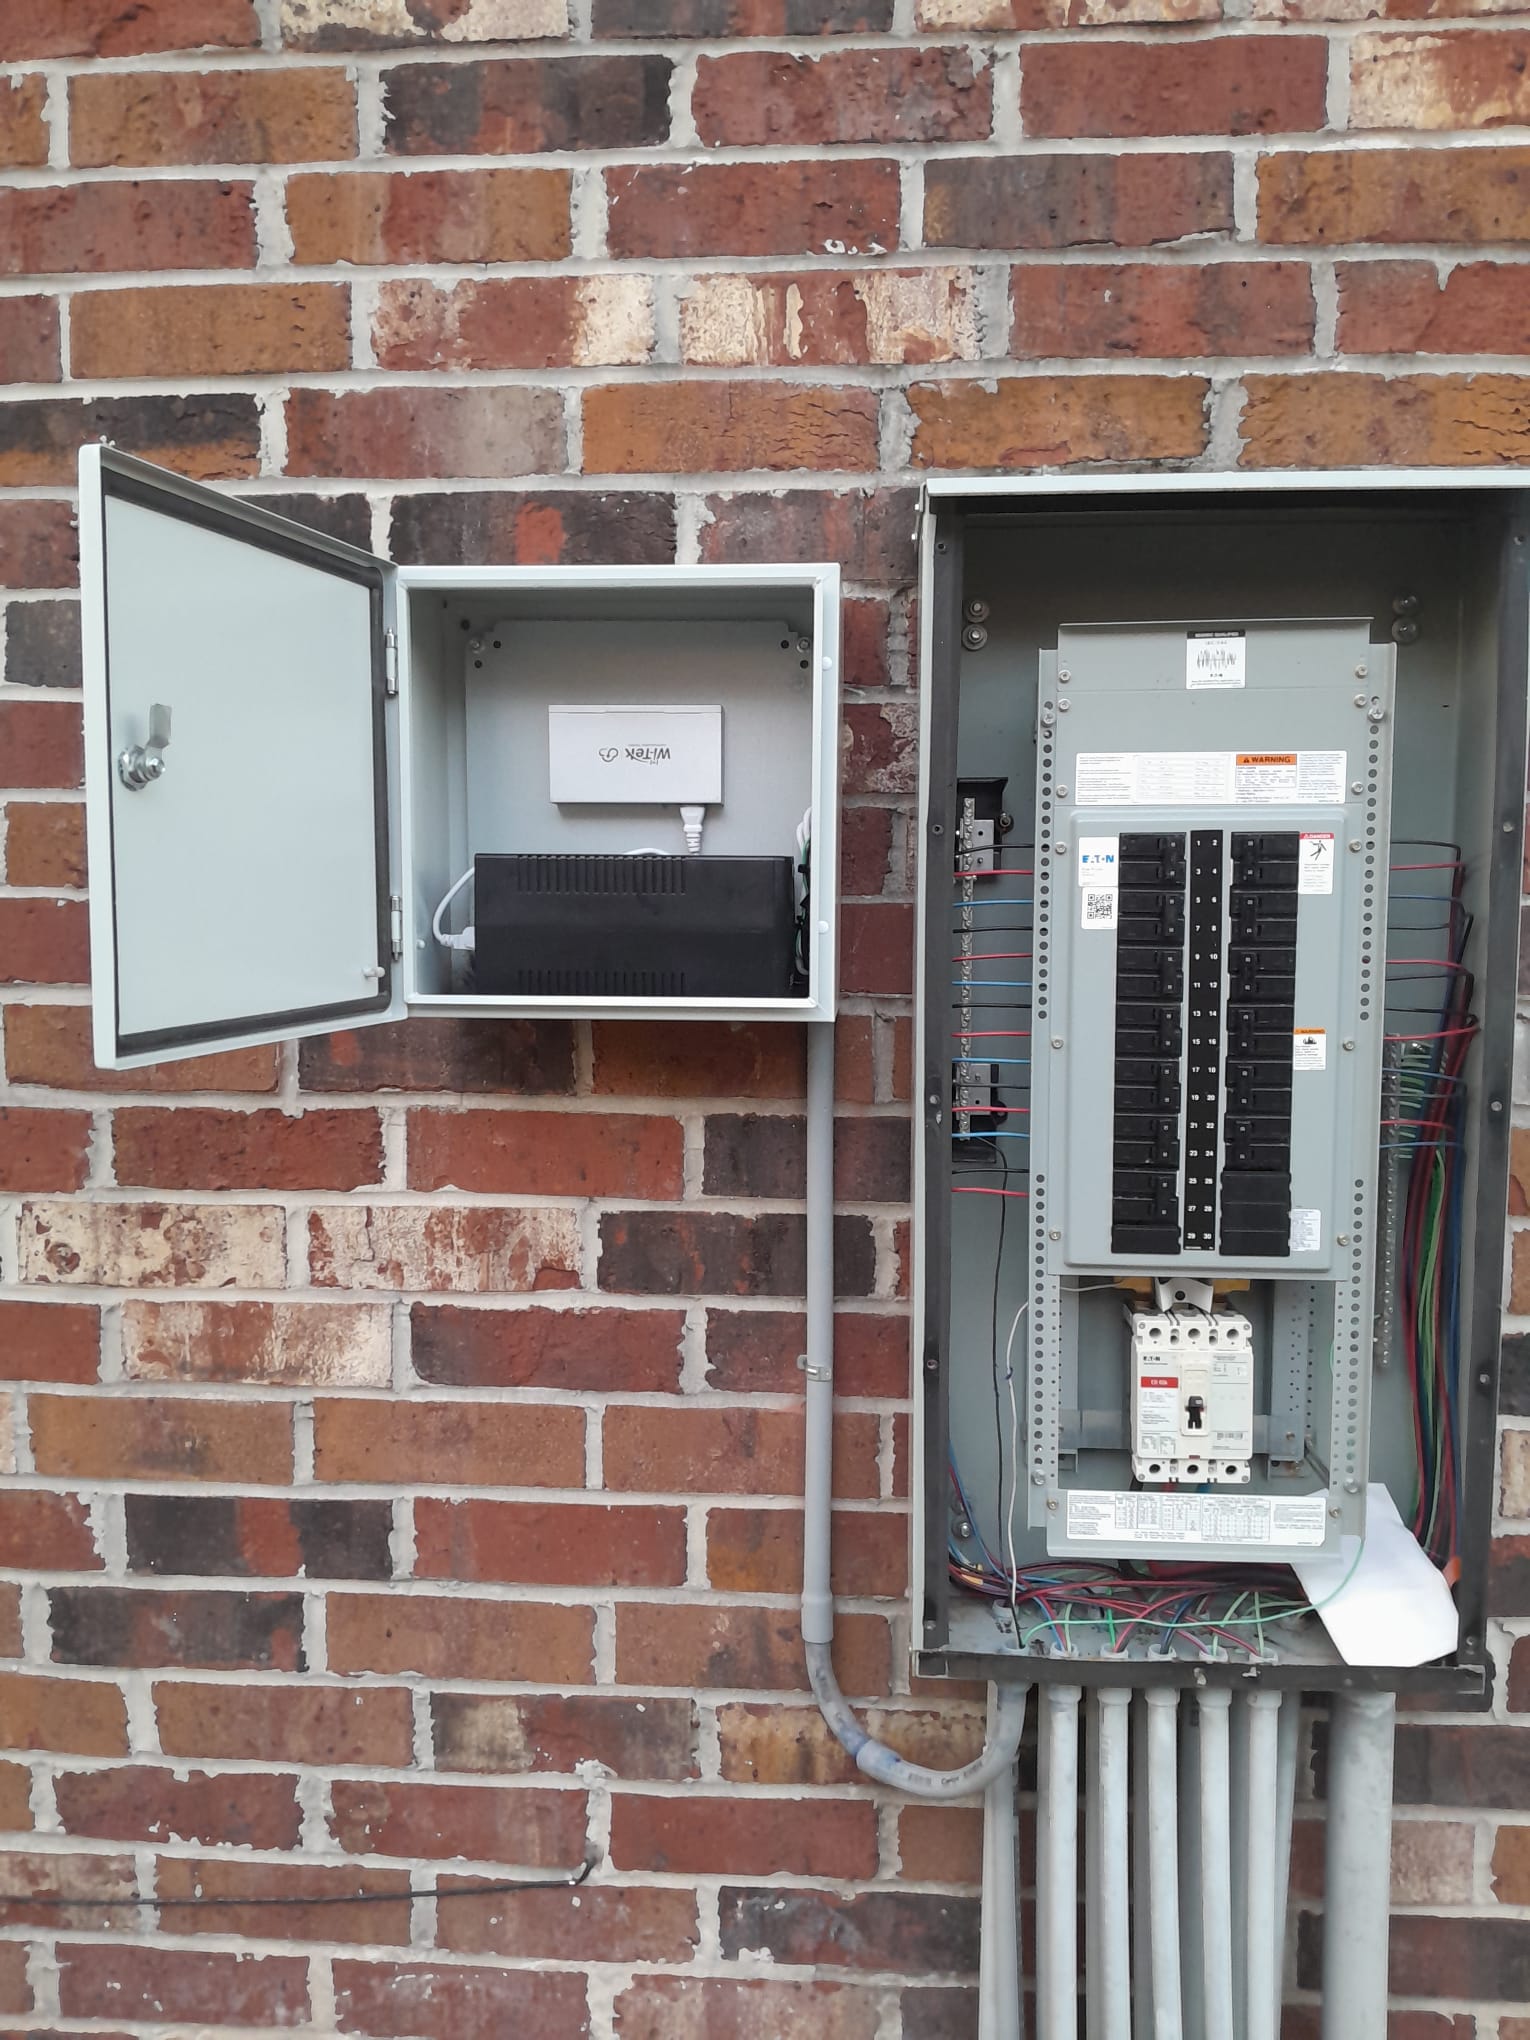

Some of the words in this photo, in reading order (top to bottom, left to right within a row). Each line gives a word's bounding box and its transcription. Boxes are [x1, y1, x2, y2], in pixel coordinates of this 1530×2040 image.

[1209, 953, 1218, 961] 10
[1193, 981, 1201, 989] 11
[1209, 981, 1218, 989] 12
[1189, 1121, 1198, 1129] 21
[1189, 1149, 1198, 1157] 23
[1188, 1177, 1198, 1185] 25
